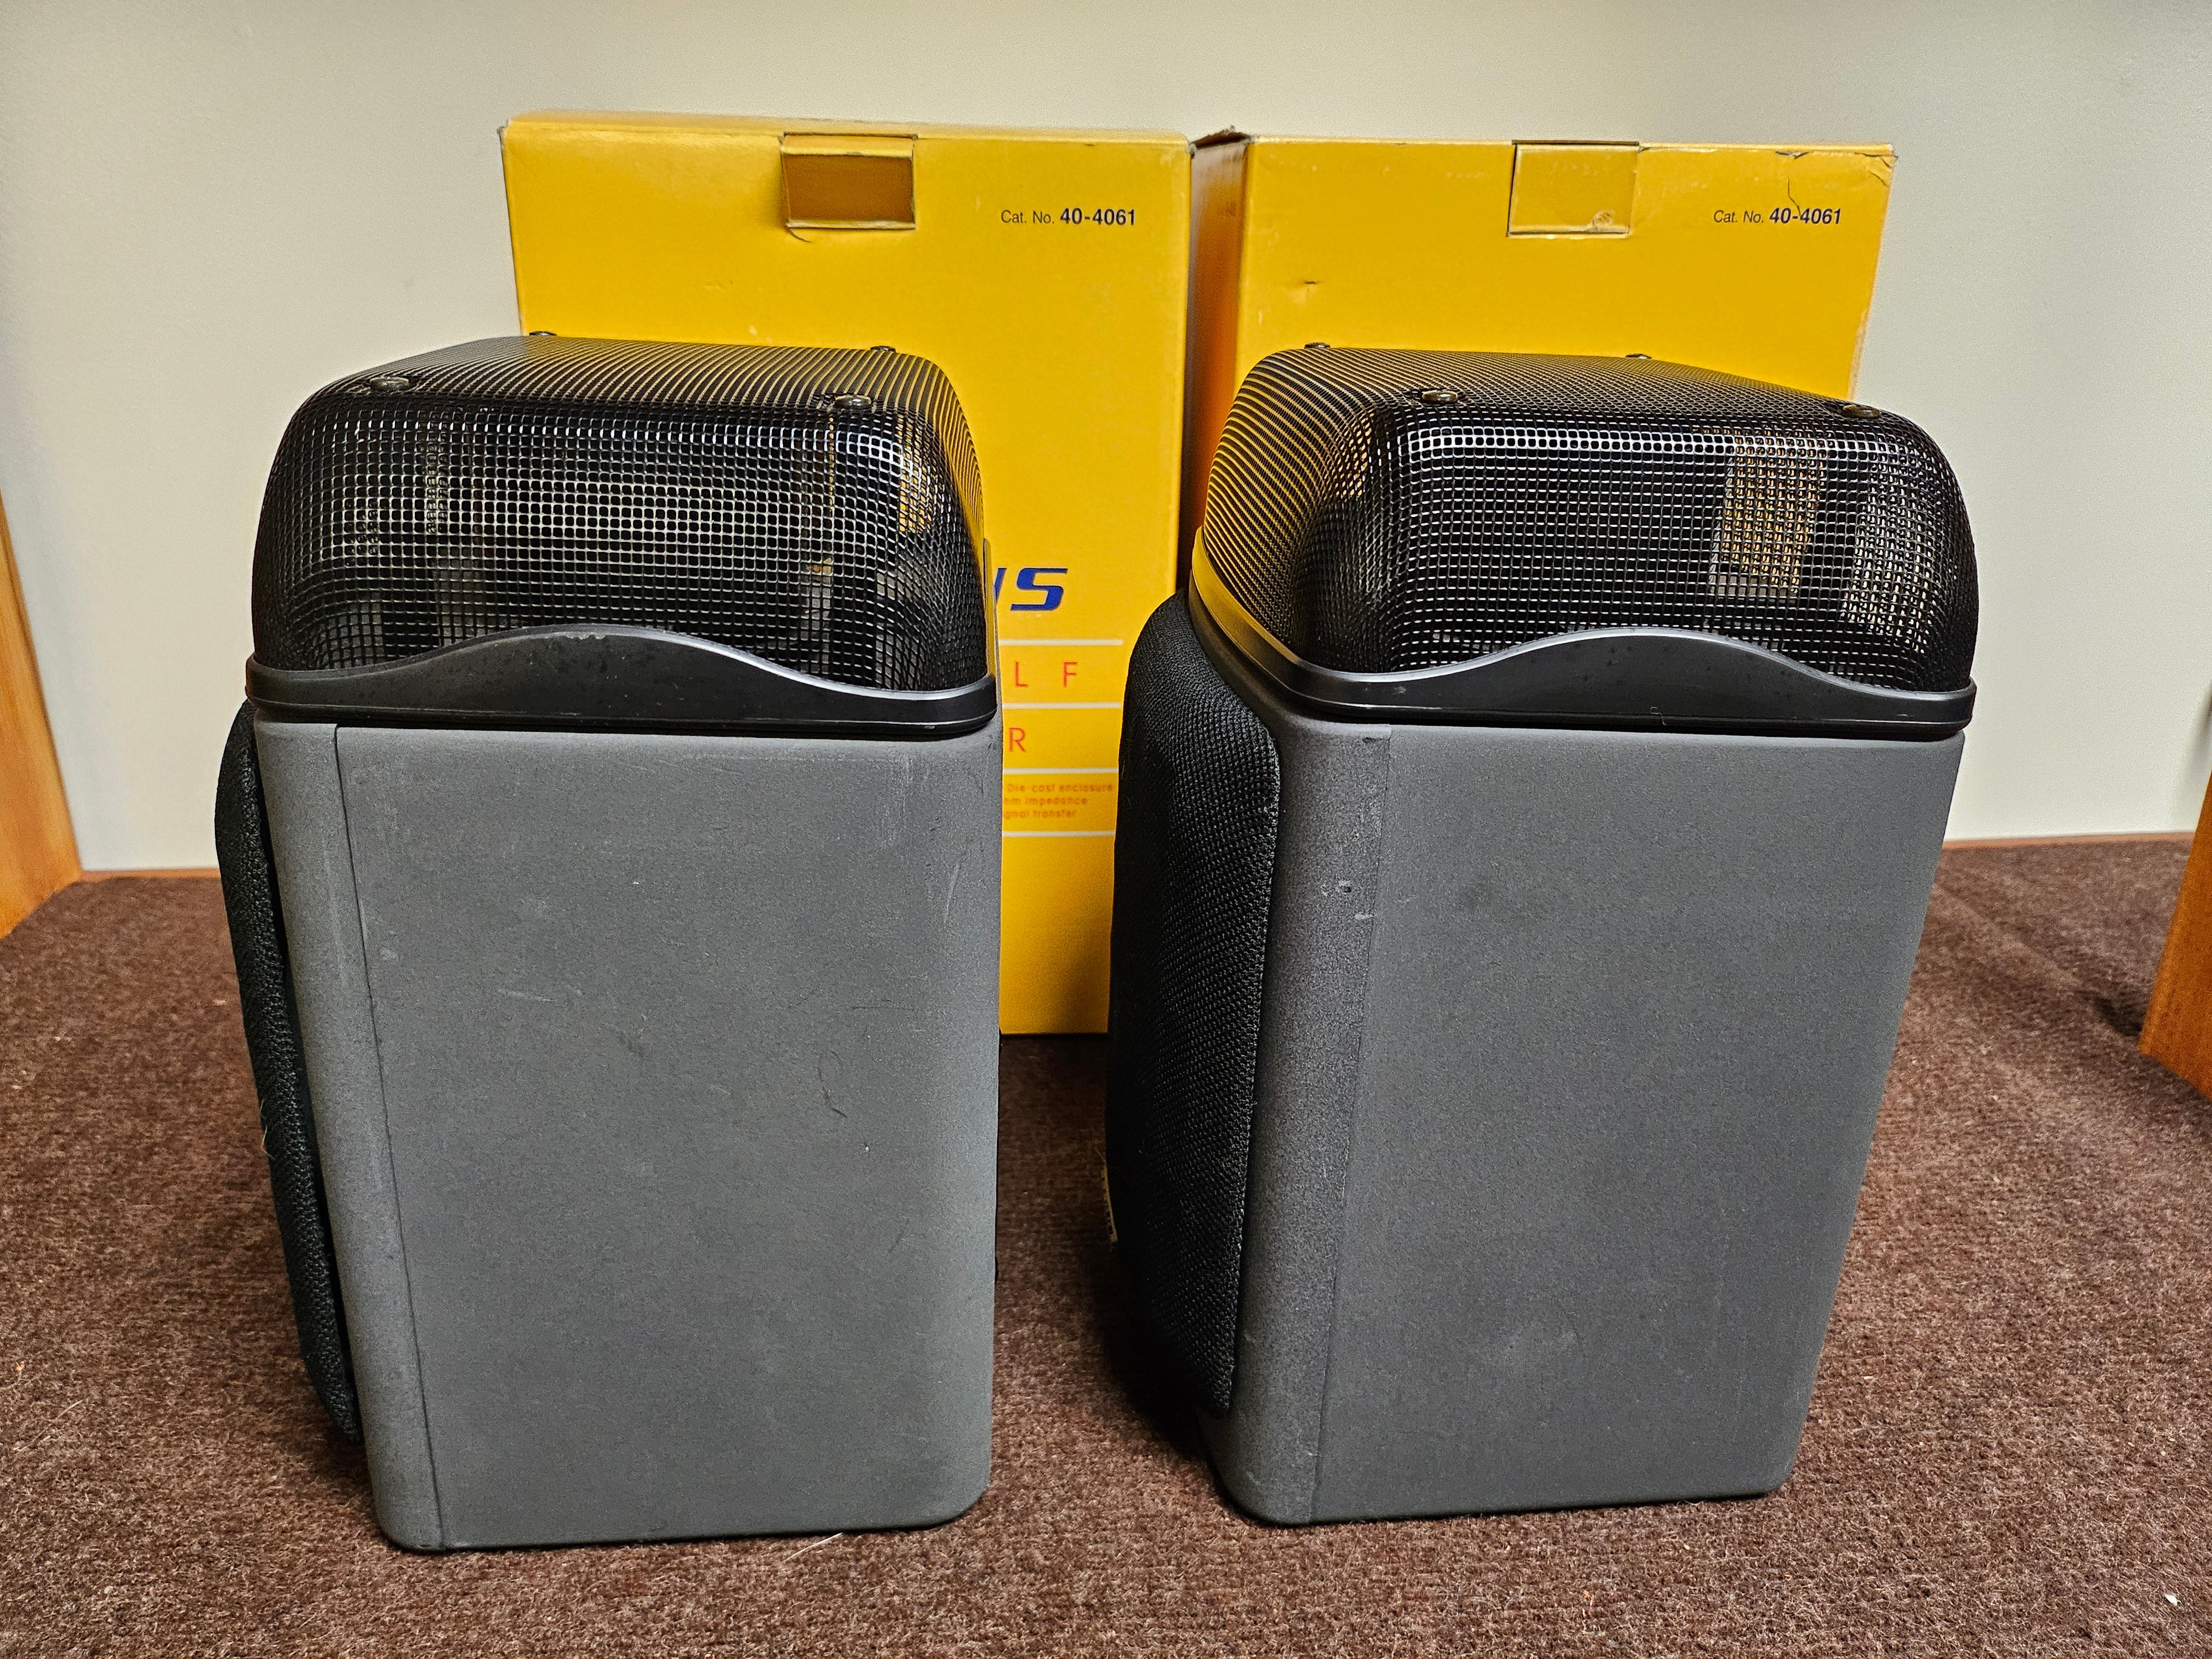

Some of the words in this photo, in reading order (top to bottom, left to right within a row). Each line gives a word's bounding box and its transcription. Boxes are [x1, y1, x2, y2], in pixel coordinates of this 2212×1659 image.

[1001, 210, 1027, 223] Cat.
[1032, 211, 1055, 224] No.
[1060, 207, 1136, 226] 40-4061
[1713, 210, 1738, 223] Cat.
[1743, 210, 1764, 223] No.
[1769, 207, 1841, 225] 40-4061
[1009, 727, 1026, 752] R
[1058, 783, 1113, 792] enclosure
[1025, 797, 1088, 806] impedance
[1033, 810, 1076, 818] transfer
